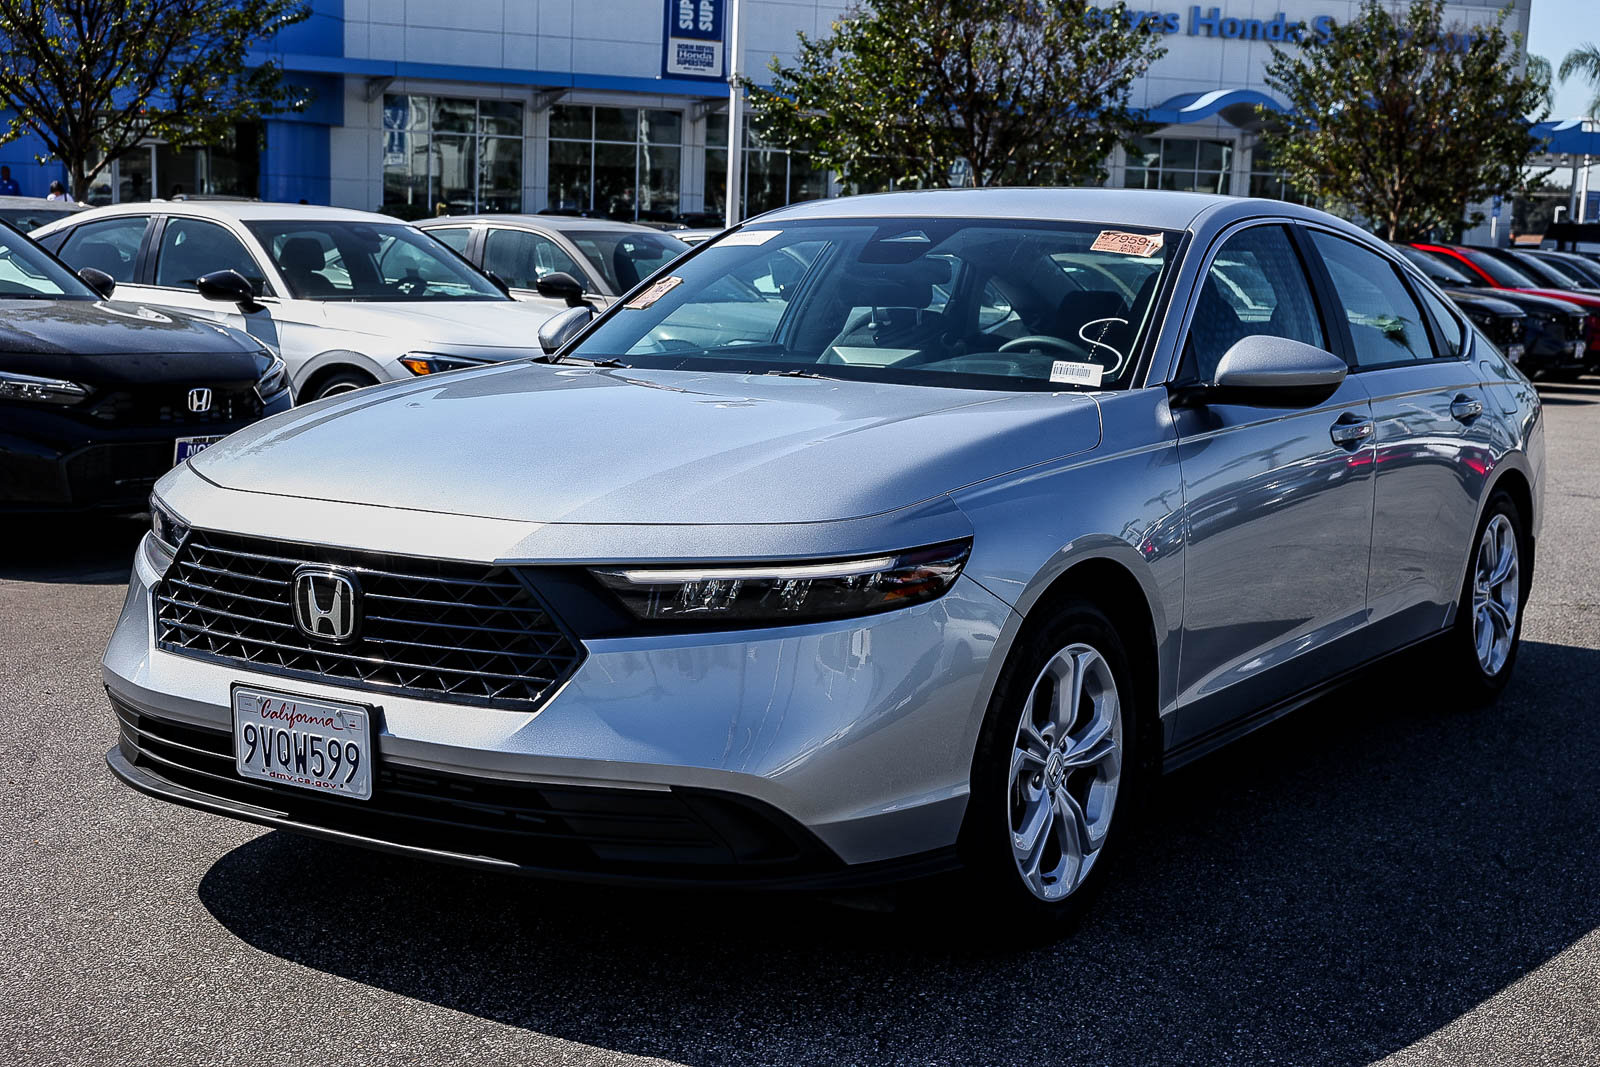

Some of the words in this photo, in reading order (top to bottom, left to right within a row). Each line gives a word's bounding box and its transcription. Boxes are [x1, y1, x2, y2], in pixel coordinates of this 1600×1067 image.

[679, 51, 713, 60] Honda
[260, 698, 344, 731] California
[243, 722, 361, 785] 9VQW599
[269, 771, 337, 789] dmv.ca.gov
